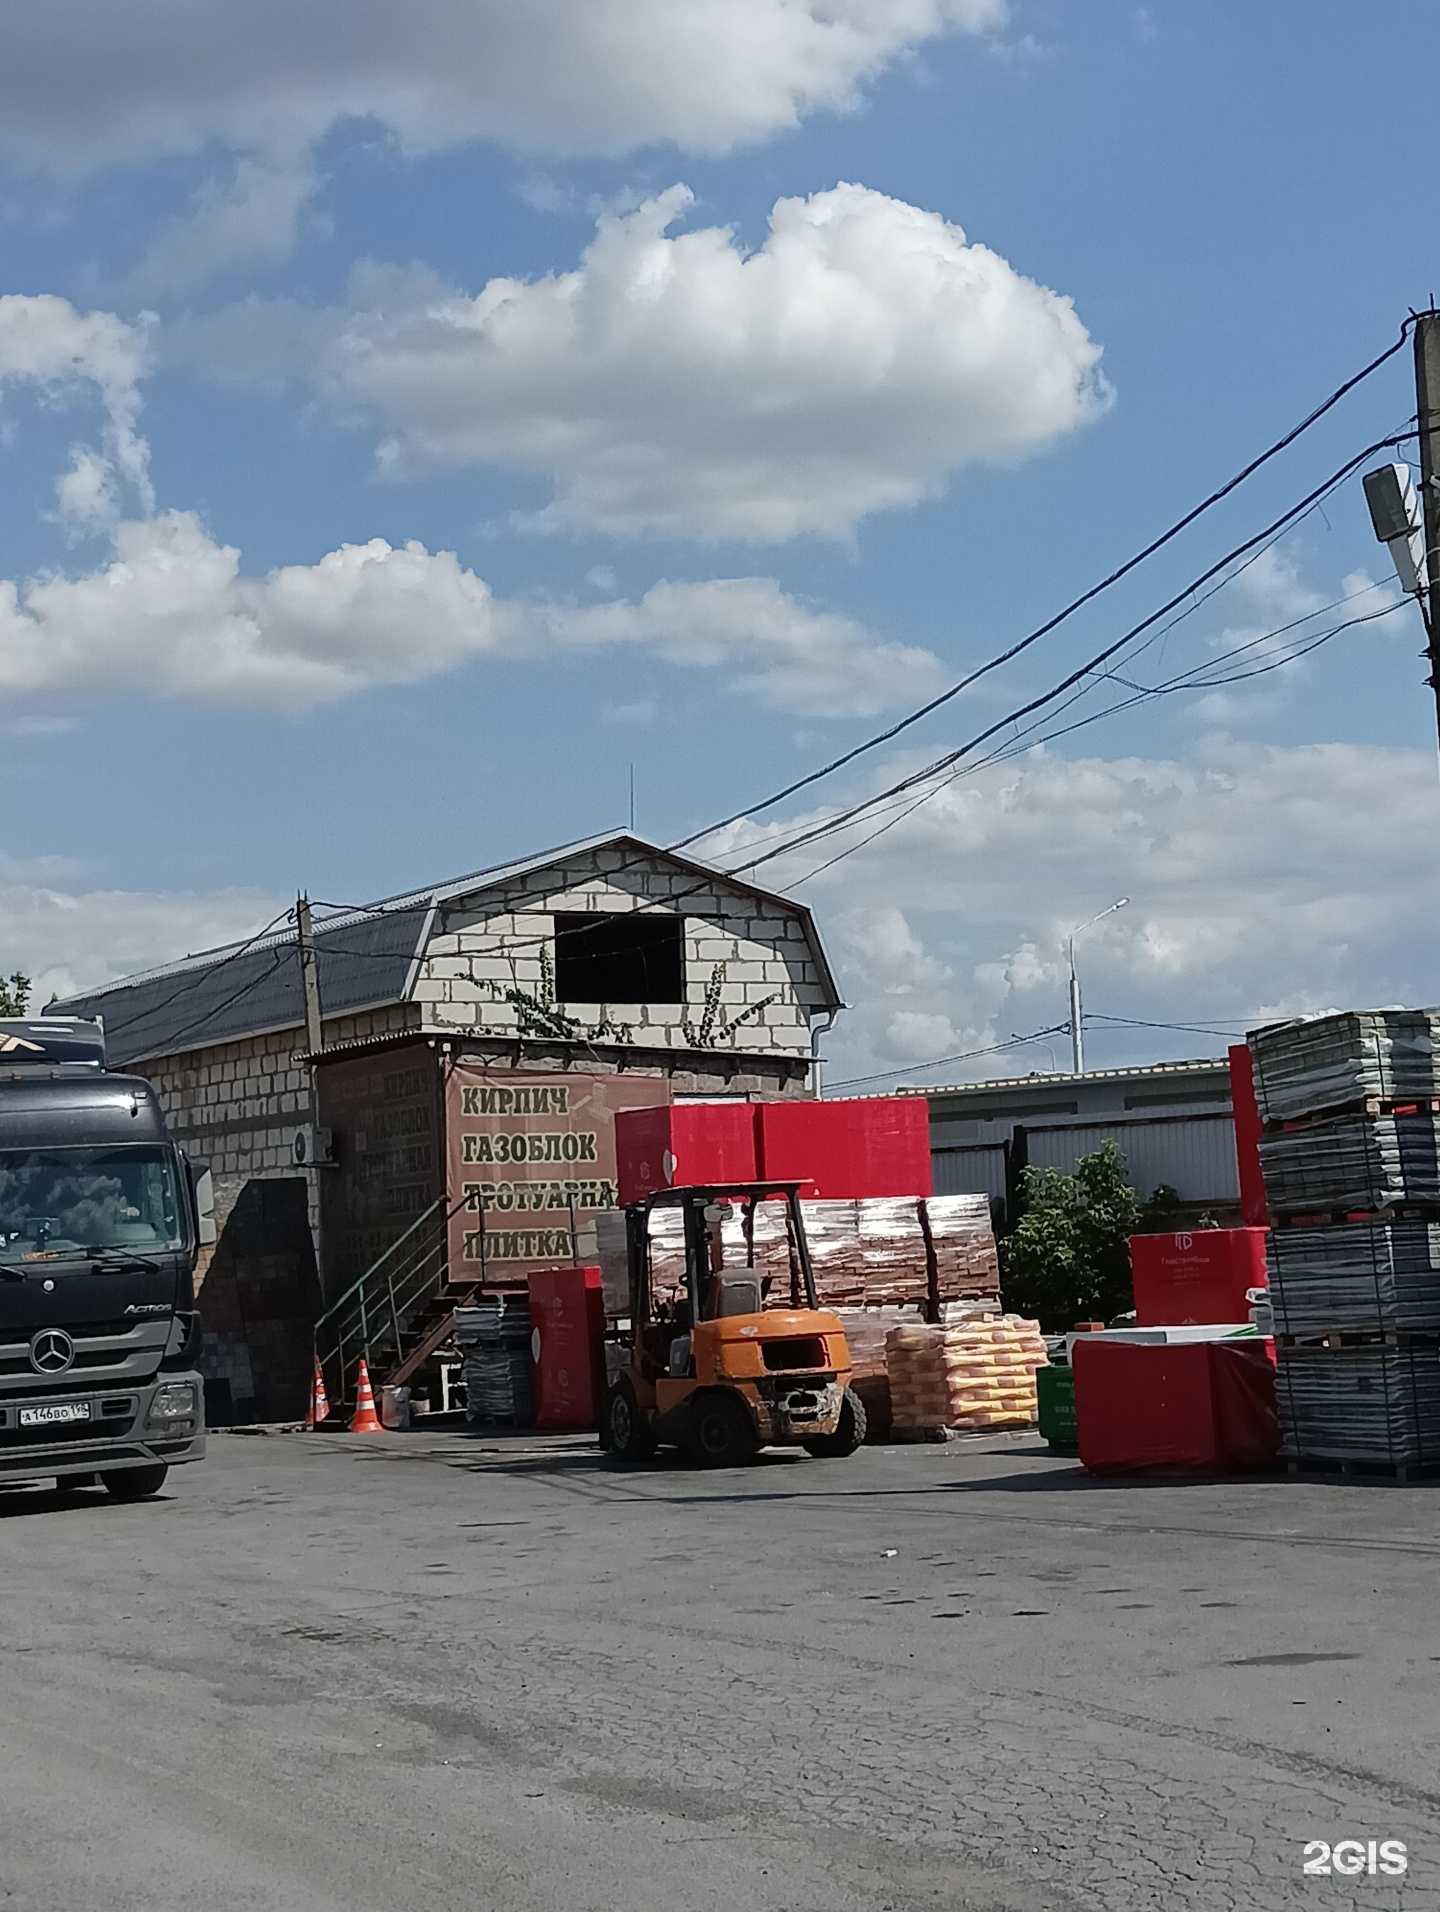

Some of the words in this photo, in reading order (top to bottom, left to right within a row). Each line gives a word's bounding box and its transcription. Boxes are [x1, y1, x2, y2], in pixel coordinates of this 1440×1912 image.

[461, 1086, 569, 1116] КИРПИЧ
[462, 1133, 598, 1163] ГАЗОБЛОК
[463, 1179, 619, 1212] ТРОТУАРНА
[463, 1228, 573, 1260] ПЛИТКА
